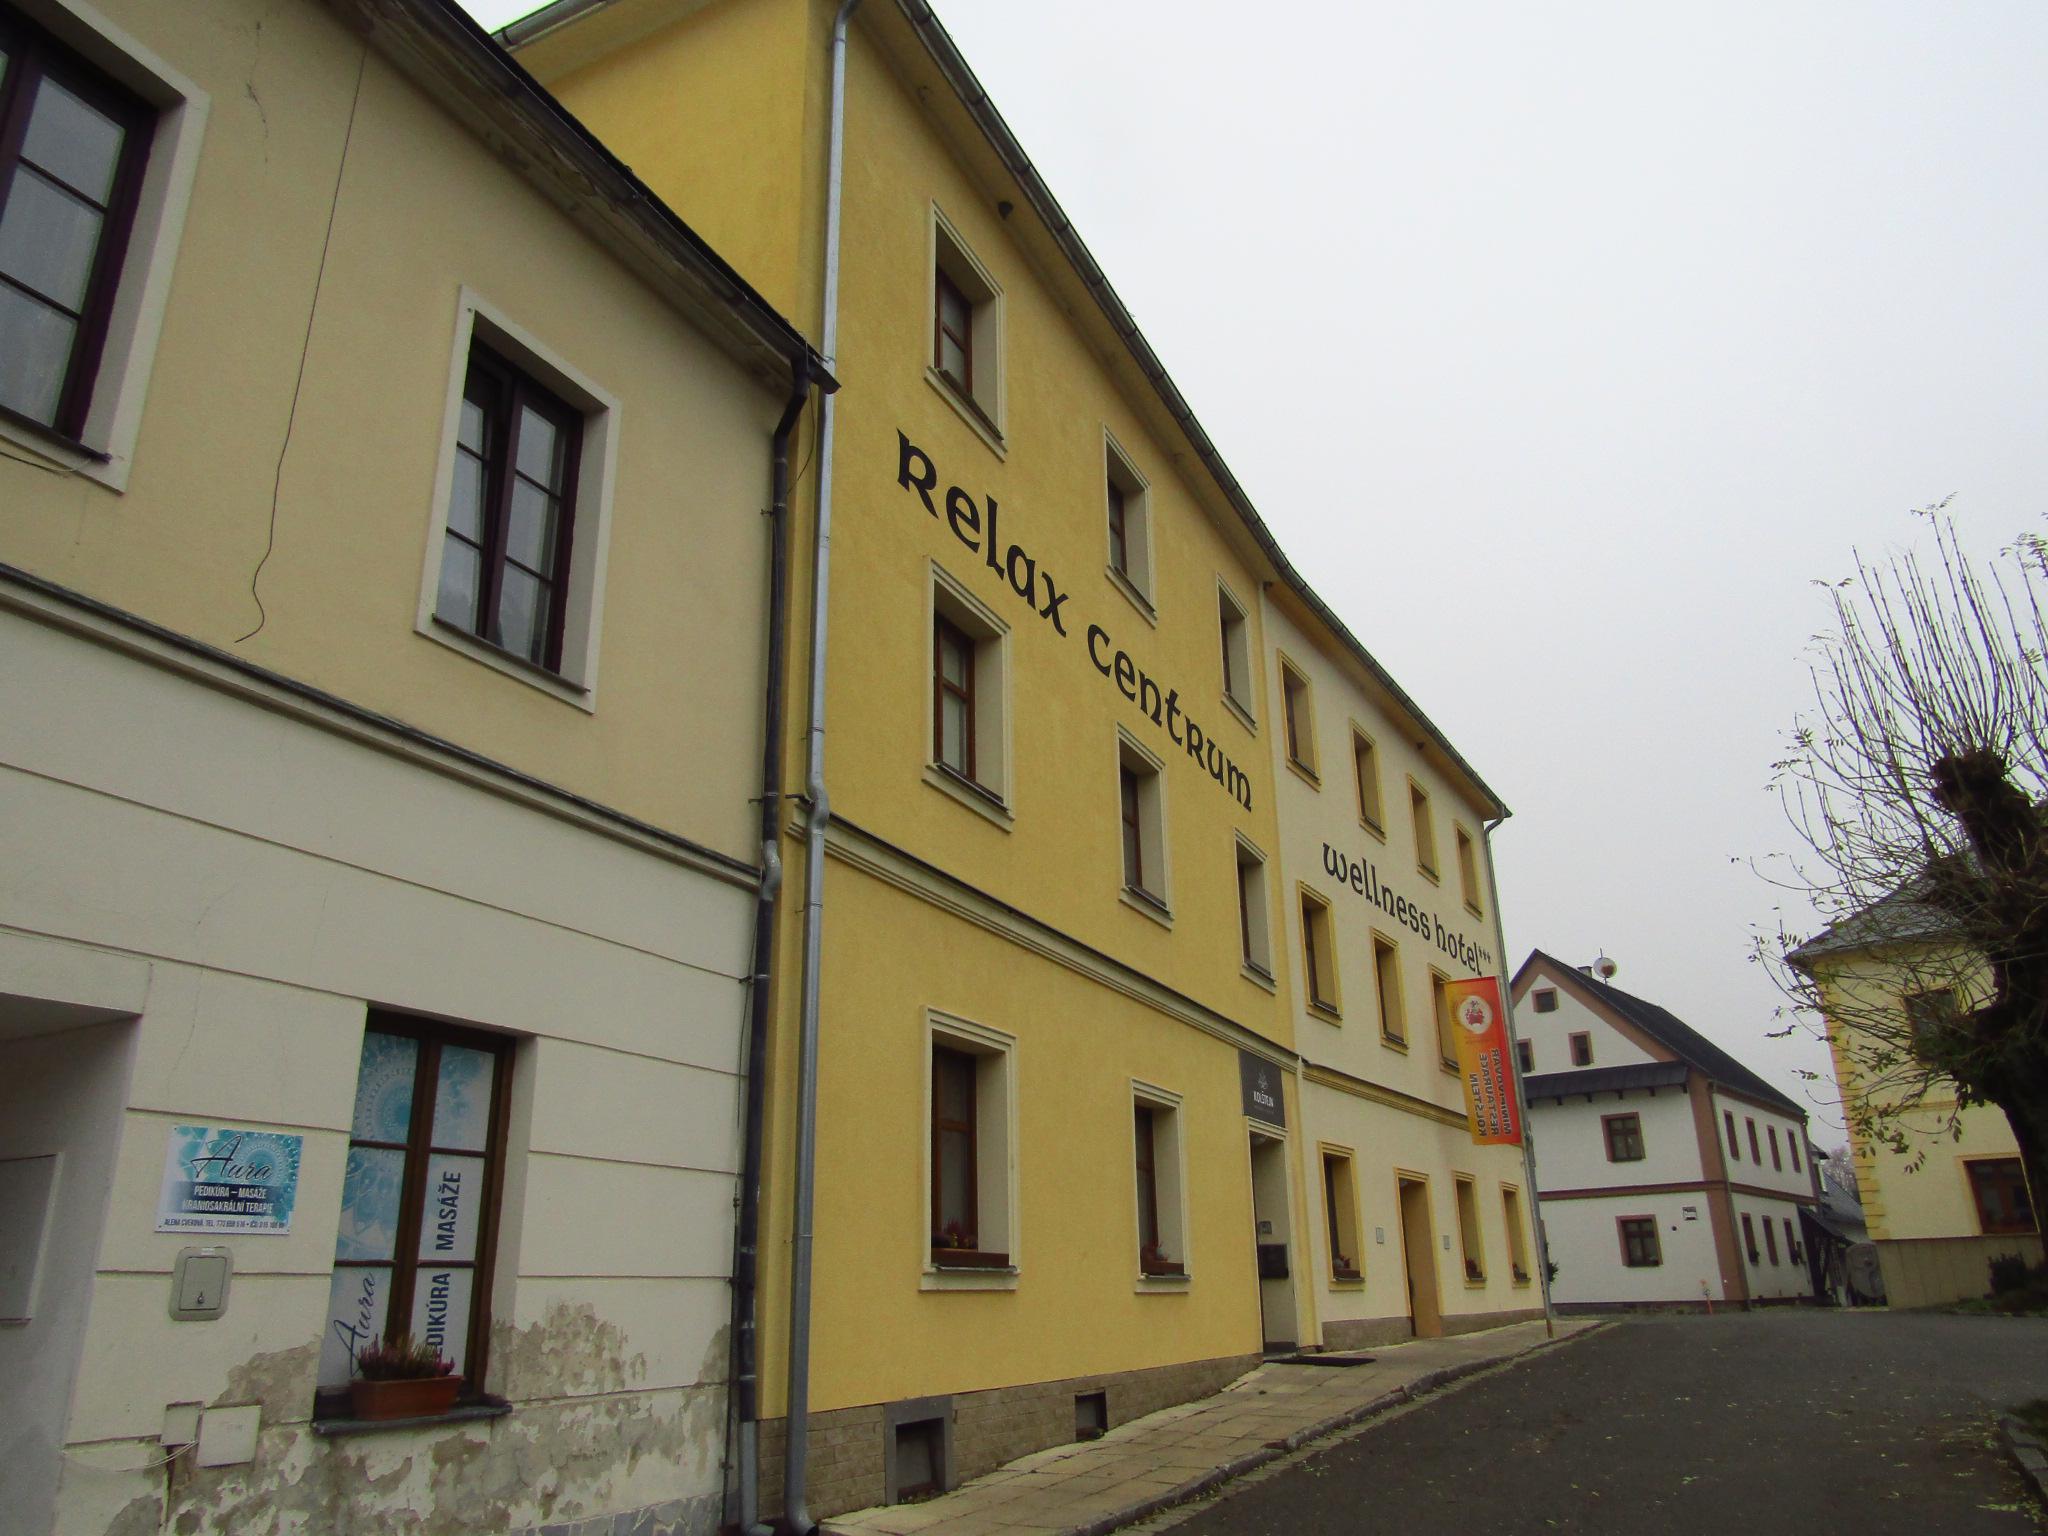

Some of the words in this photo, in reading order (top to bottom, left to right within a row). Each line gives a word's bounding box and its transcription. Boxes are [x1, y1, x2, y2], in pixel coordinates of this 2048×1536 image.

[896, 427, 1069, 638] Relax
[1323, 842, 1431, 941] wellness
[190, 1135, 272, 1180] Aura
[194, 1184, 230, 1197] PEDIKÚRA
[238, 1187, 267, 1199] MASÁŽE
[246, 1202, 274, 1213] TERAPIE
[435, 1171, 461, 1251] MASÁŽE
[333, 1272, 378, 1377] Aura
